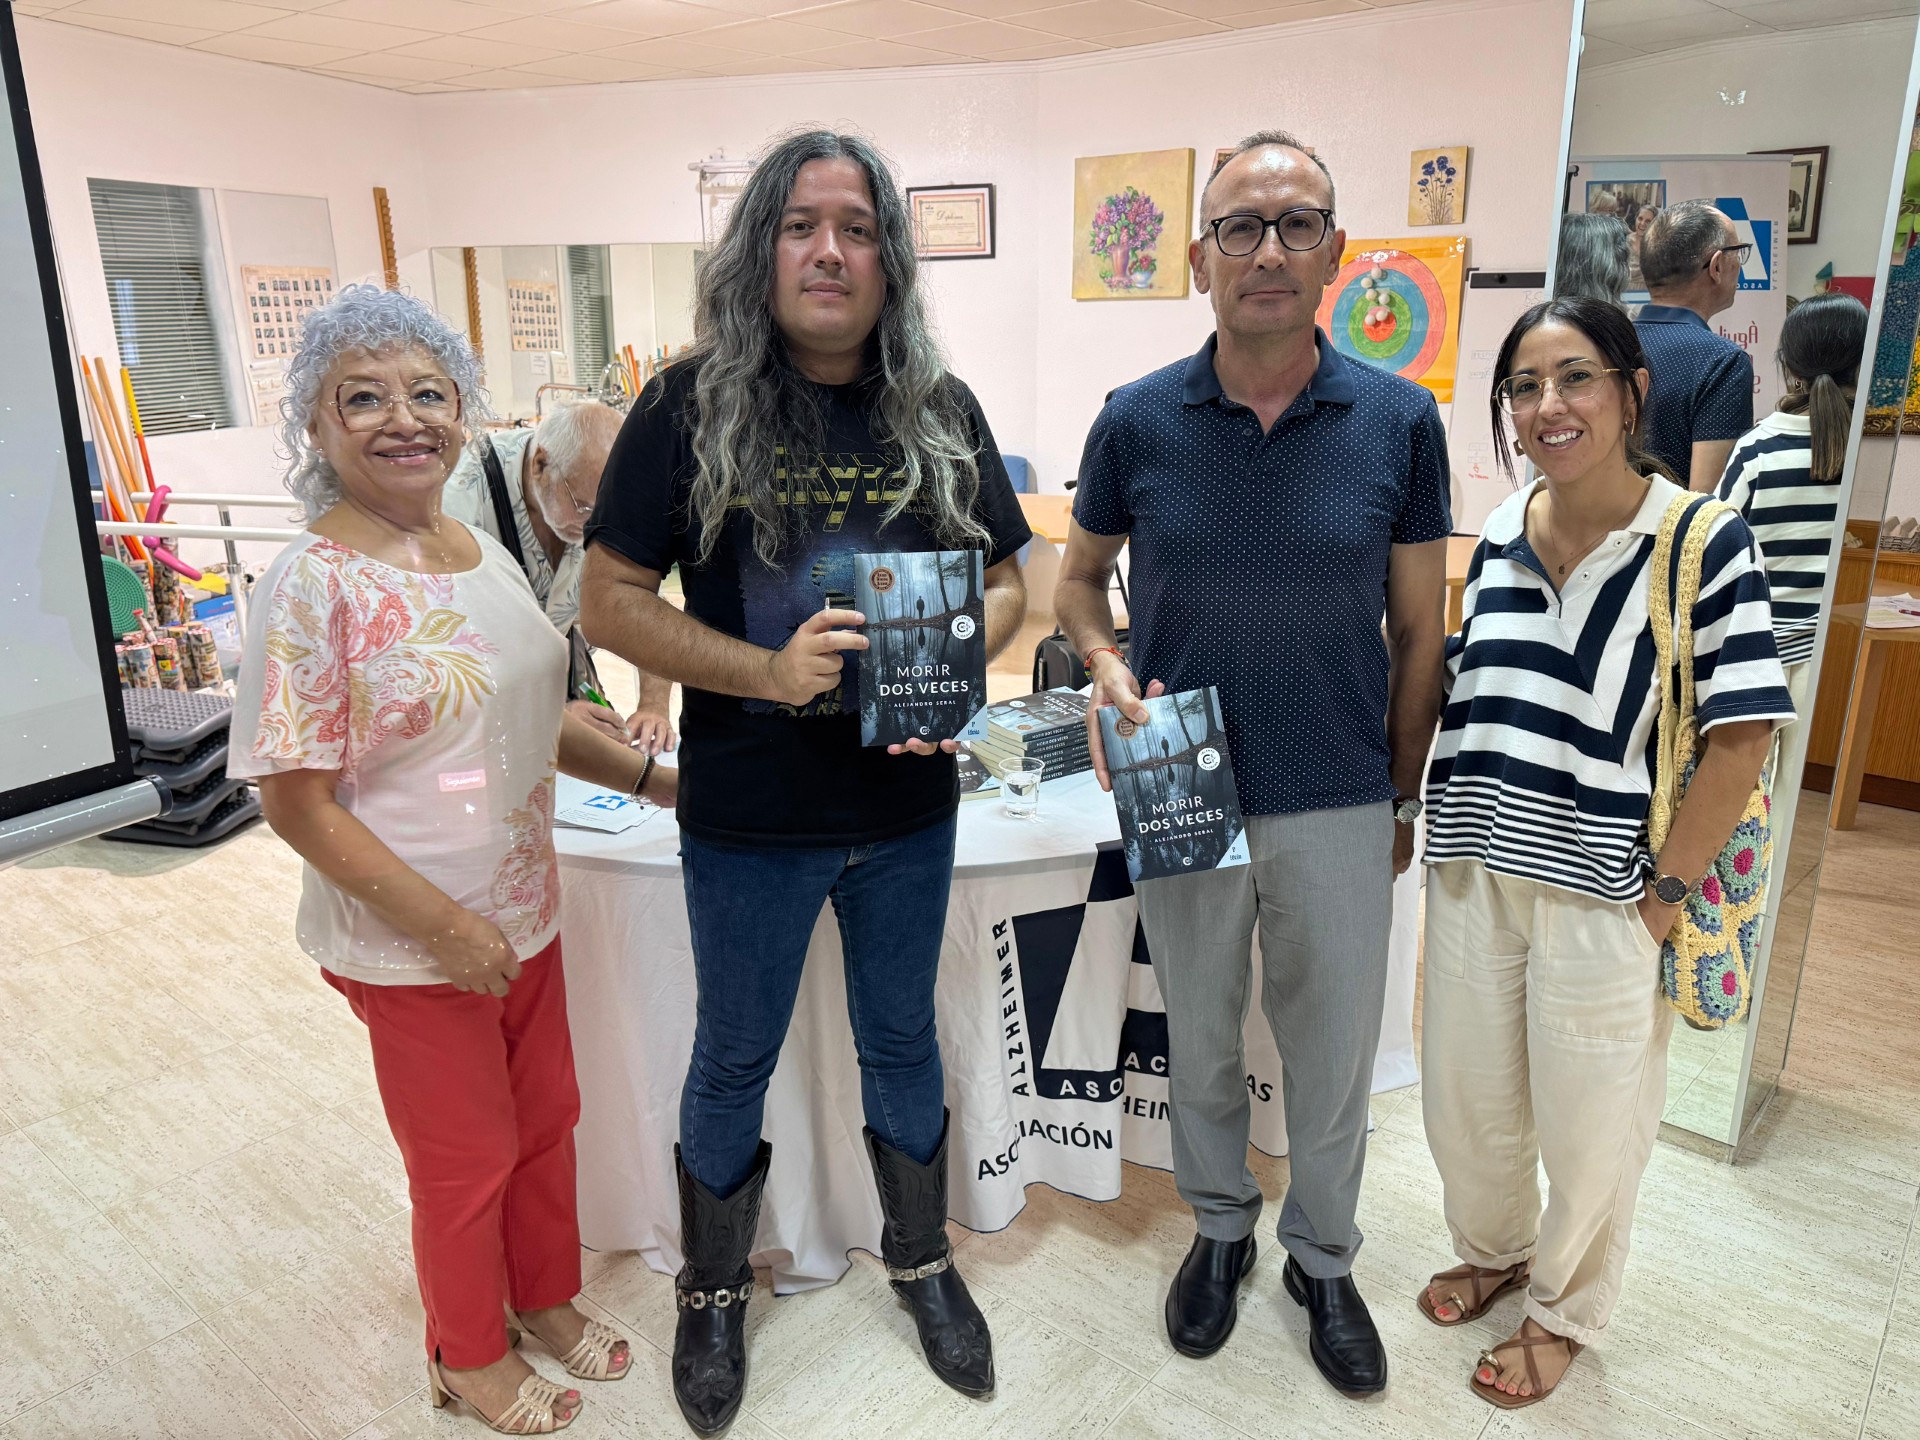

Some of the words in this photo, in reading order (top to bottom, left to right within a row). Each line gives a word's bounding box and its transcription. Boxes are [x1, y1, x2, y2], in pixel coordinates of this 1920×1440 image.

[897, 664, 951, 678] MORIR
[879, 683, 913, 697] DOS
[918, 680, 969, 695] VECES
[1152, 795, 1204, 815] MORIR
[1138, 818, 1171, 834] DOS
[1174, 808, 1224, 827] VECES
[1154, 833, 1192, 843] ALEJANDRO
[992, 918, 1030, 1096] ALZHEIMER
